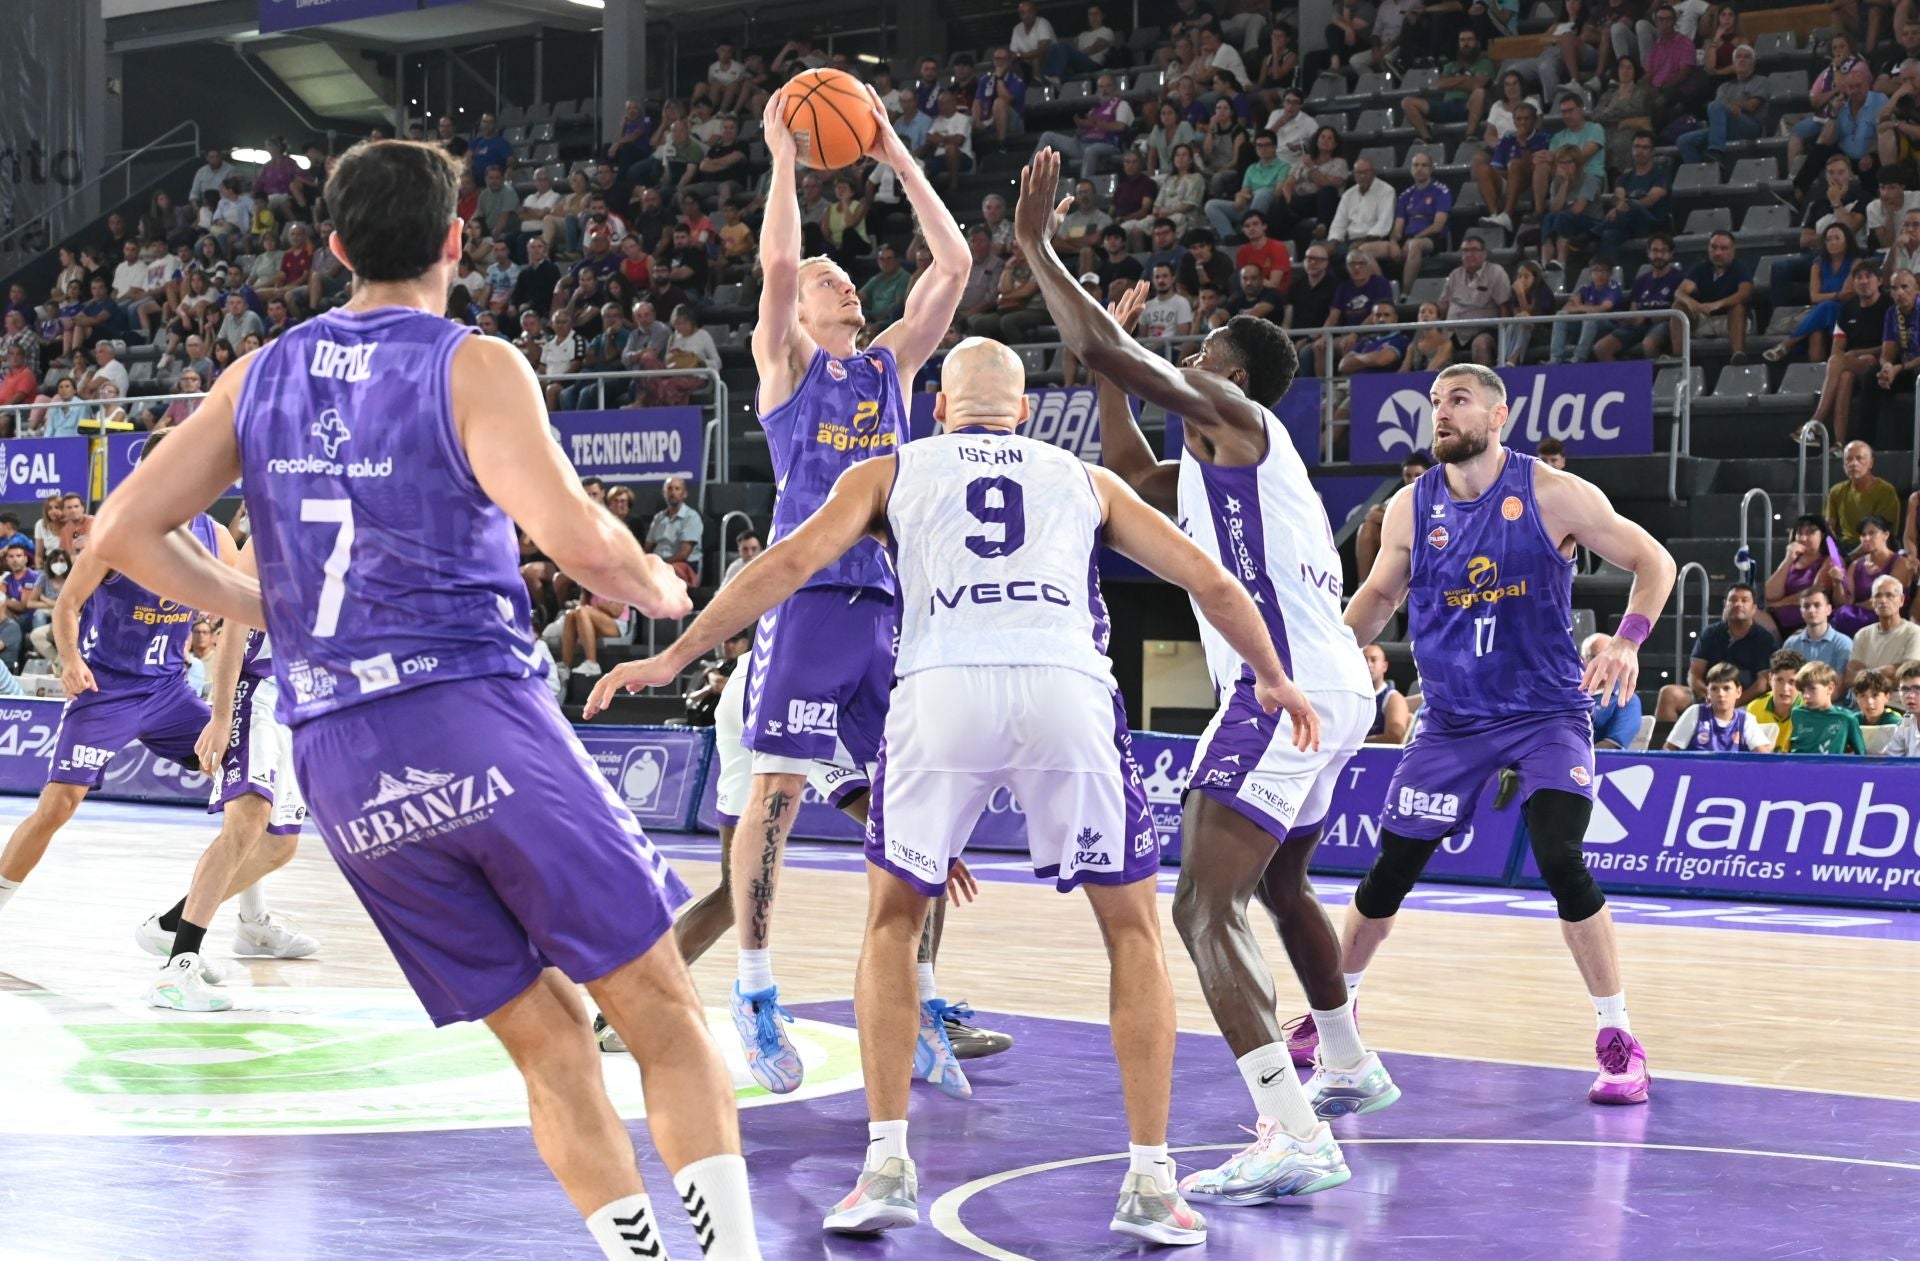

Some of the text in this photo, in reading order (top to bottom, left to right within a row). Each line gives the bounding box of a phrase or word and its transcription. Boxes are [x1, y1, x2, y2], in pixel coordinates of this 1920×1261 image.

[571, 430, 682, 466] TECNICAMPO
[10, 453, 61, 485] GAL
[347, 456, 393, 478] salud
[965, 475, 1026, 559] 9
[300, 498, 355, 637] 7
[930, 581, 1071, 616] IVECO
[1446, 580, 1527, 609] agropal
[133, 610, 193, 625] agropal
[144, 634, 169, 665] 21
[1474, 615, 1497, 657] 17
[402, 655, 439, 676] Dip
[335, 765, 515, 854] LEBANZA
[1398, 786, 1459, 816] gaza
[891, 839, 938, 872] SYNERGIA
[1134, 828, 1154, 852] CBC
[1655, 850, 1787, 881] frigoríficas
